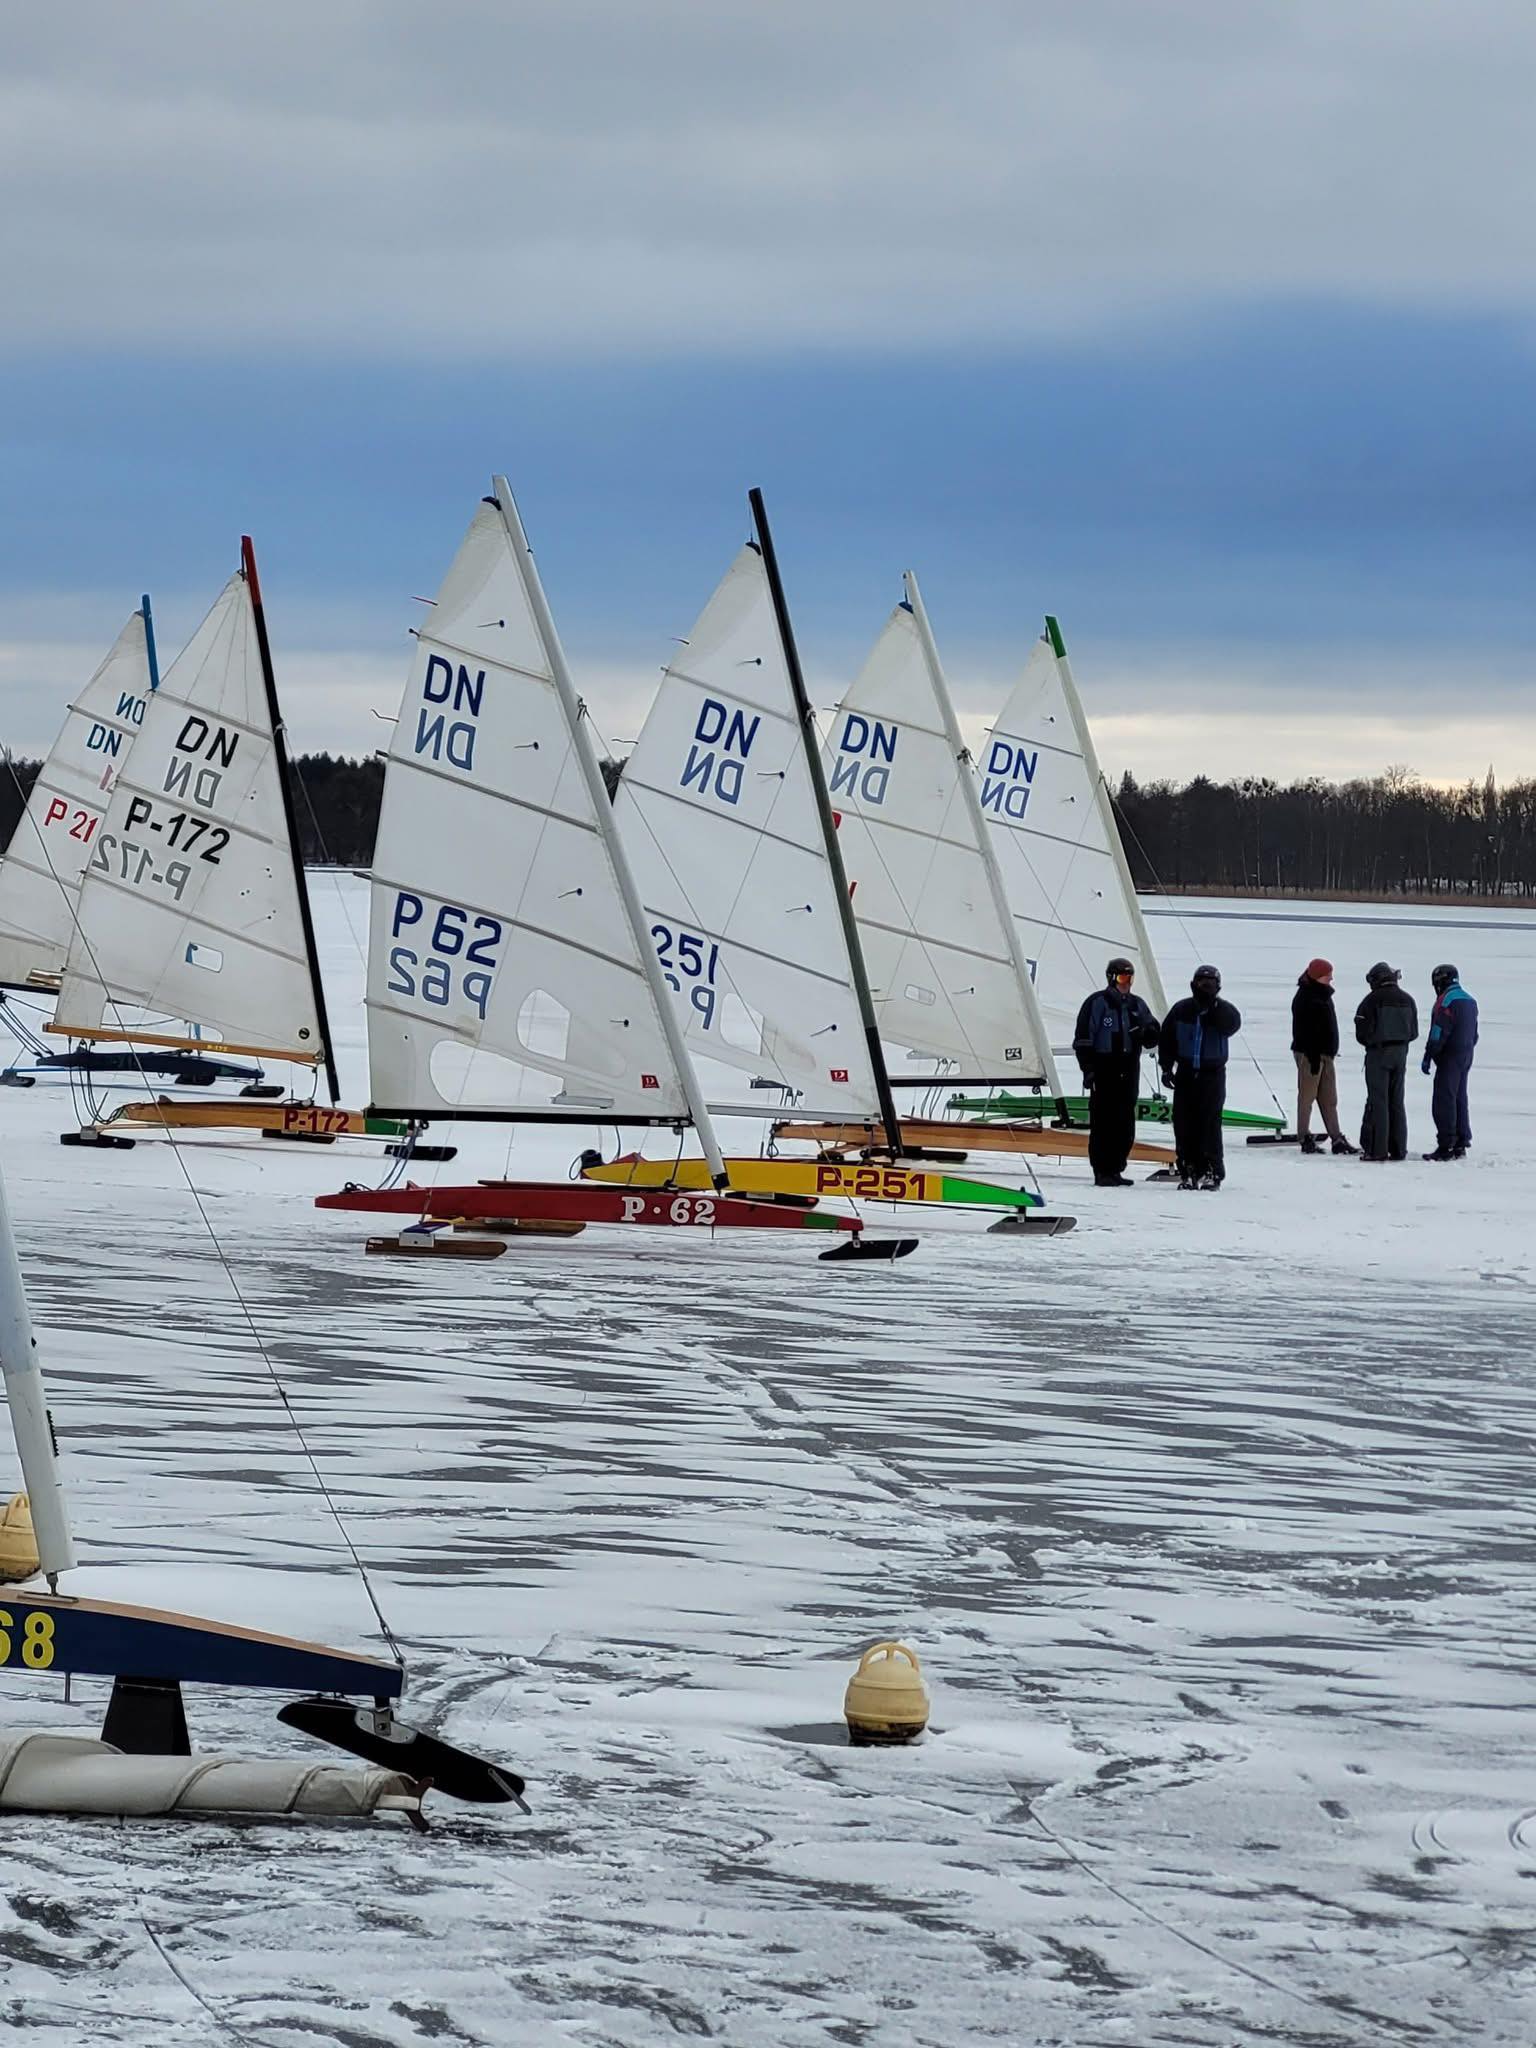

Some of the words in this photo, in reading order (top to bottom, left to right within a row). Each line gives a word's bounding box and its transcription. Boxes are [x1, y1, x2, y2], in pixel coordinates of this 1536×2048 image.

[423, 653, 486, 717] DN
[87, 723, 122, 757] DN
[176, 715, 240, 769] DN
[695, 698, 761, 758] DN
[841, 713, 898, 763] DN
[988, 740, 1039, 783] DN
[45, 797, 68, 827] P
[69, 809, 99, 844] 21
[124, 796, 230, 865] P-172
[392, 891, 424, 939] P
[432, 905, 503, 968] 62
[651, 924, 719, 985] 251
[284, 1108, 350, 1134] P-172
[816, 1165, 926, 1202] P-251
[0, 1609, 55, 1669] 68
